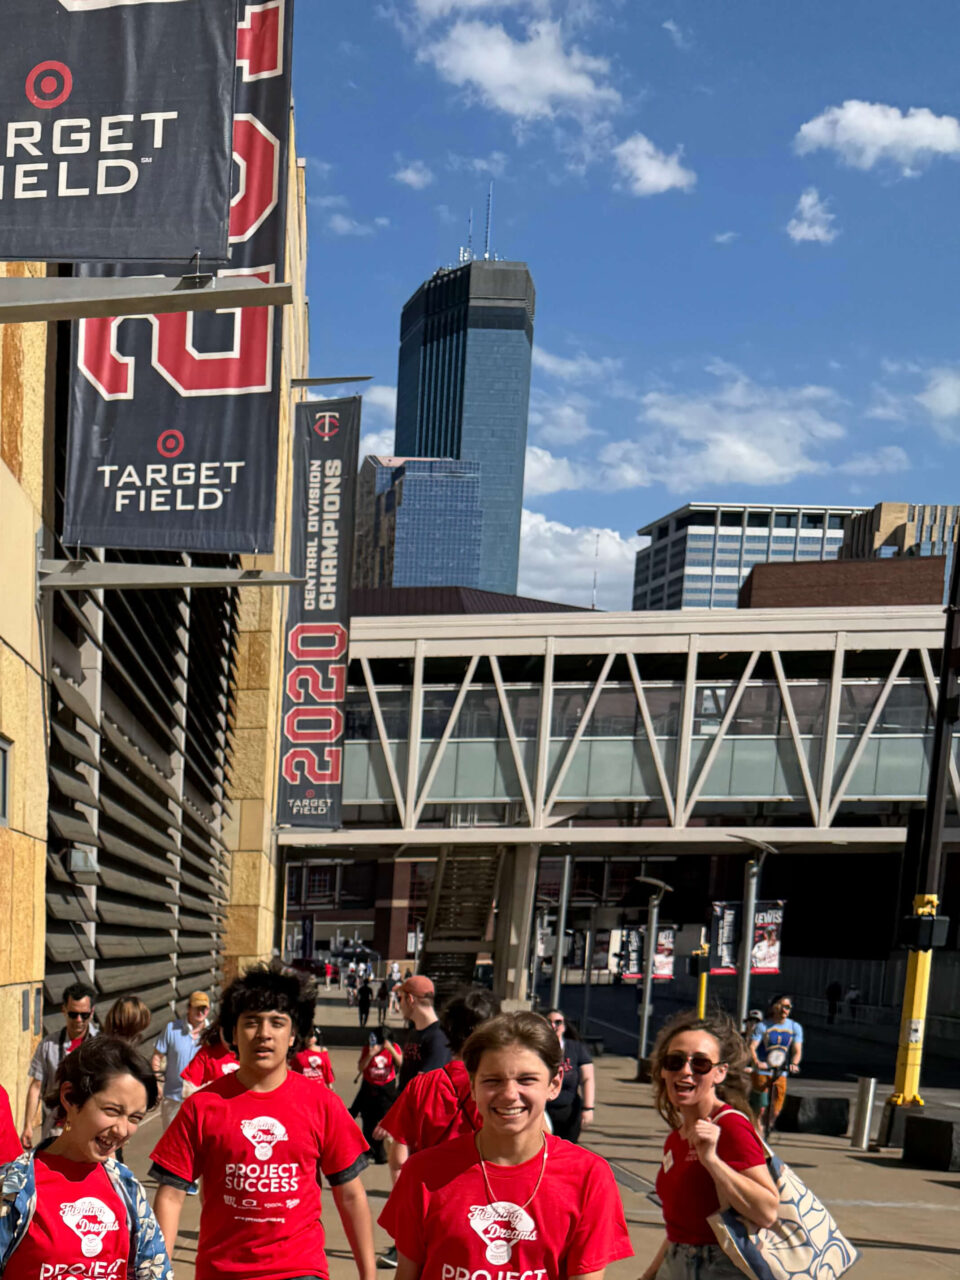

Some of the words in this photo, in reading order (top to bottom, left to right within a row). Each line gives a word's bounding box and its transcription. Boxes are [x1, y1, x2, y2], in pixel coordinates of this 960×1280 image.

[97, 461, 245, 487] TARGET
[115, 487, 224, 512] FIELD
[307, 460, 322, 533] DIVISION
[319, 458, 342, 611] CHAMPIONS
[304, 537, 318, 611] CENTRAL
[282, 622, 348, 785] 2020
[288, 799, 333, 808] TARGET
[292, 806, 327, 815] FIELD
[225, 1163, 299, 1178] PROJECT
[225, 1176, 298, 1193] SUCCESS
[486, 1223, 538, 1240] Dreams
